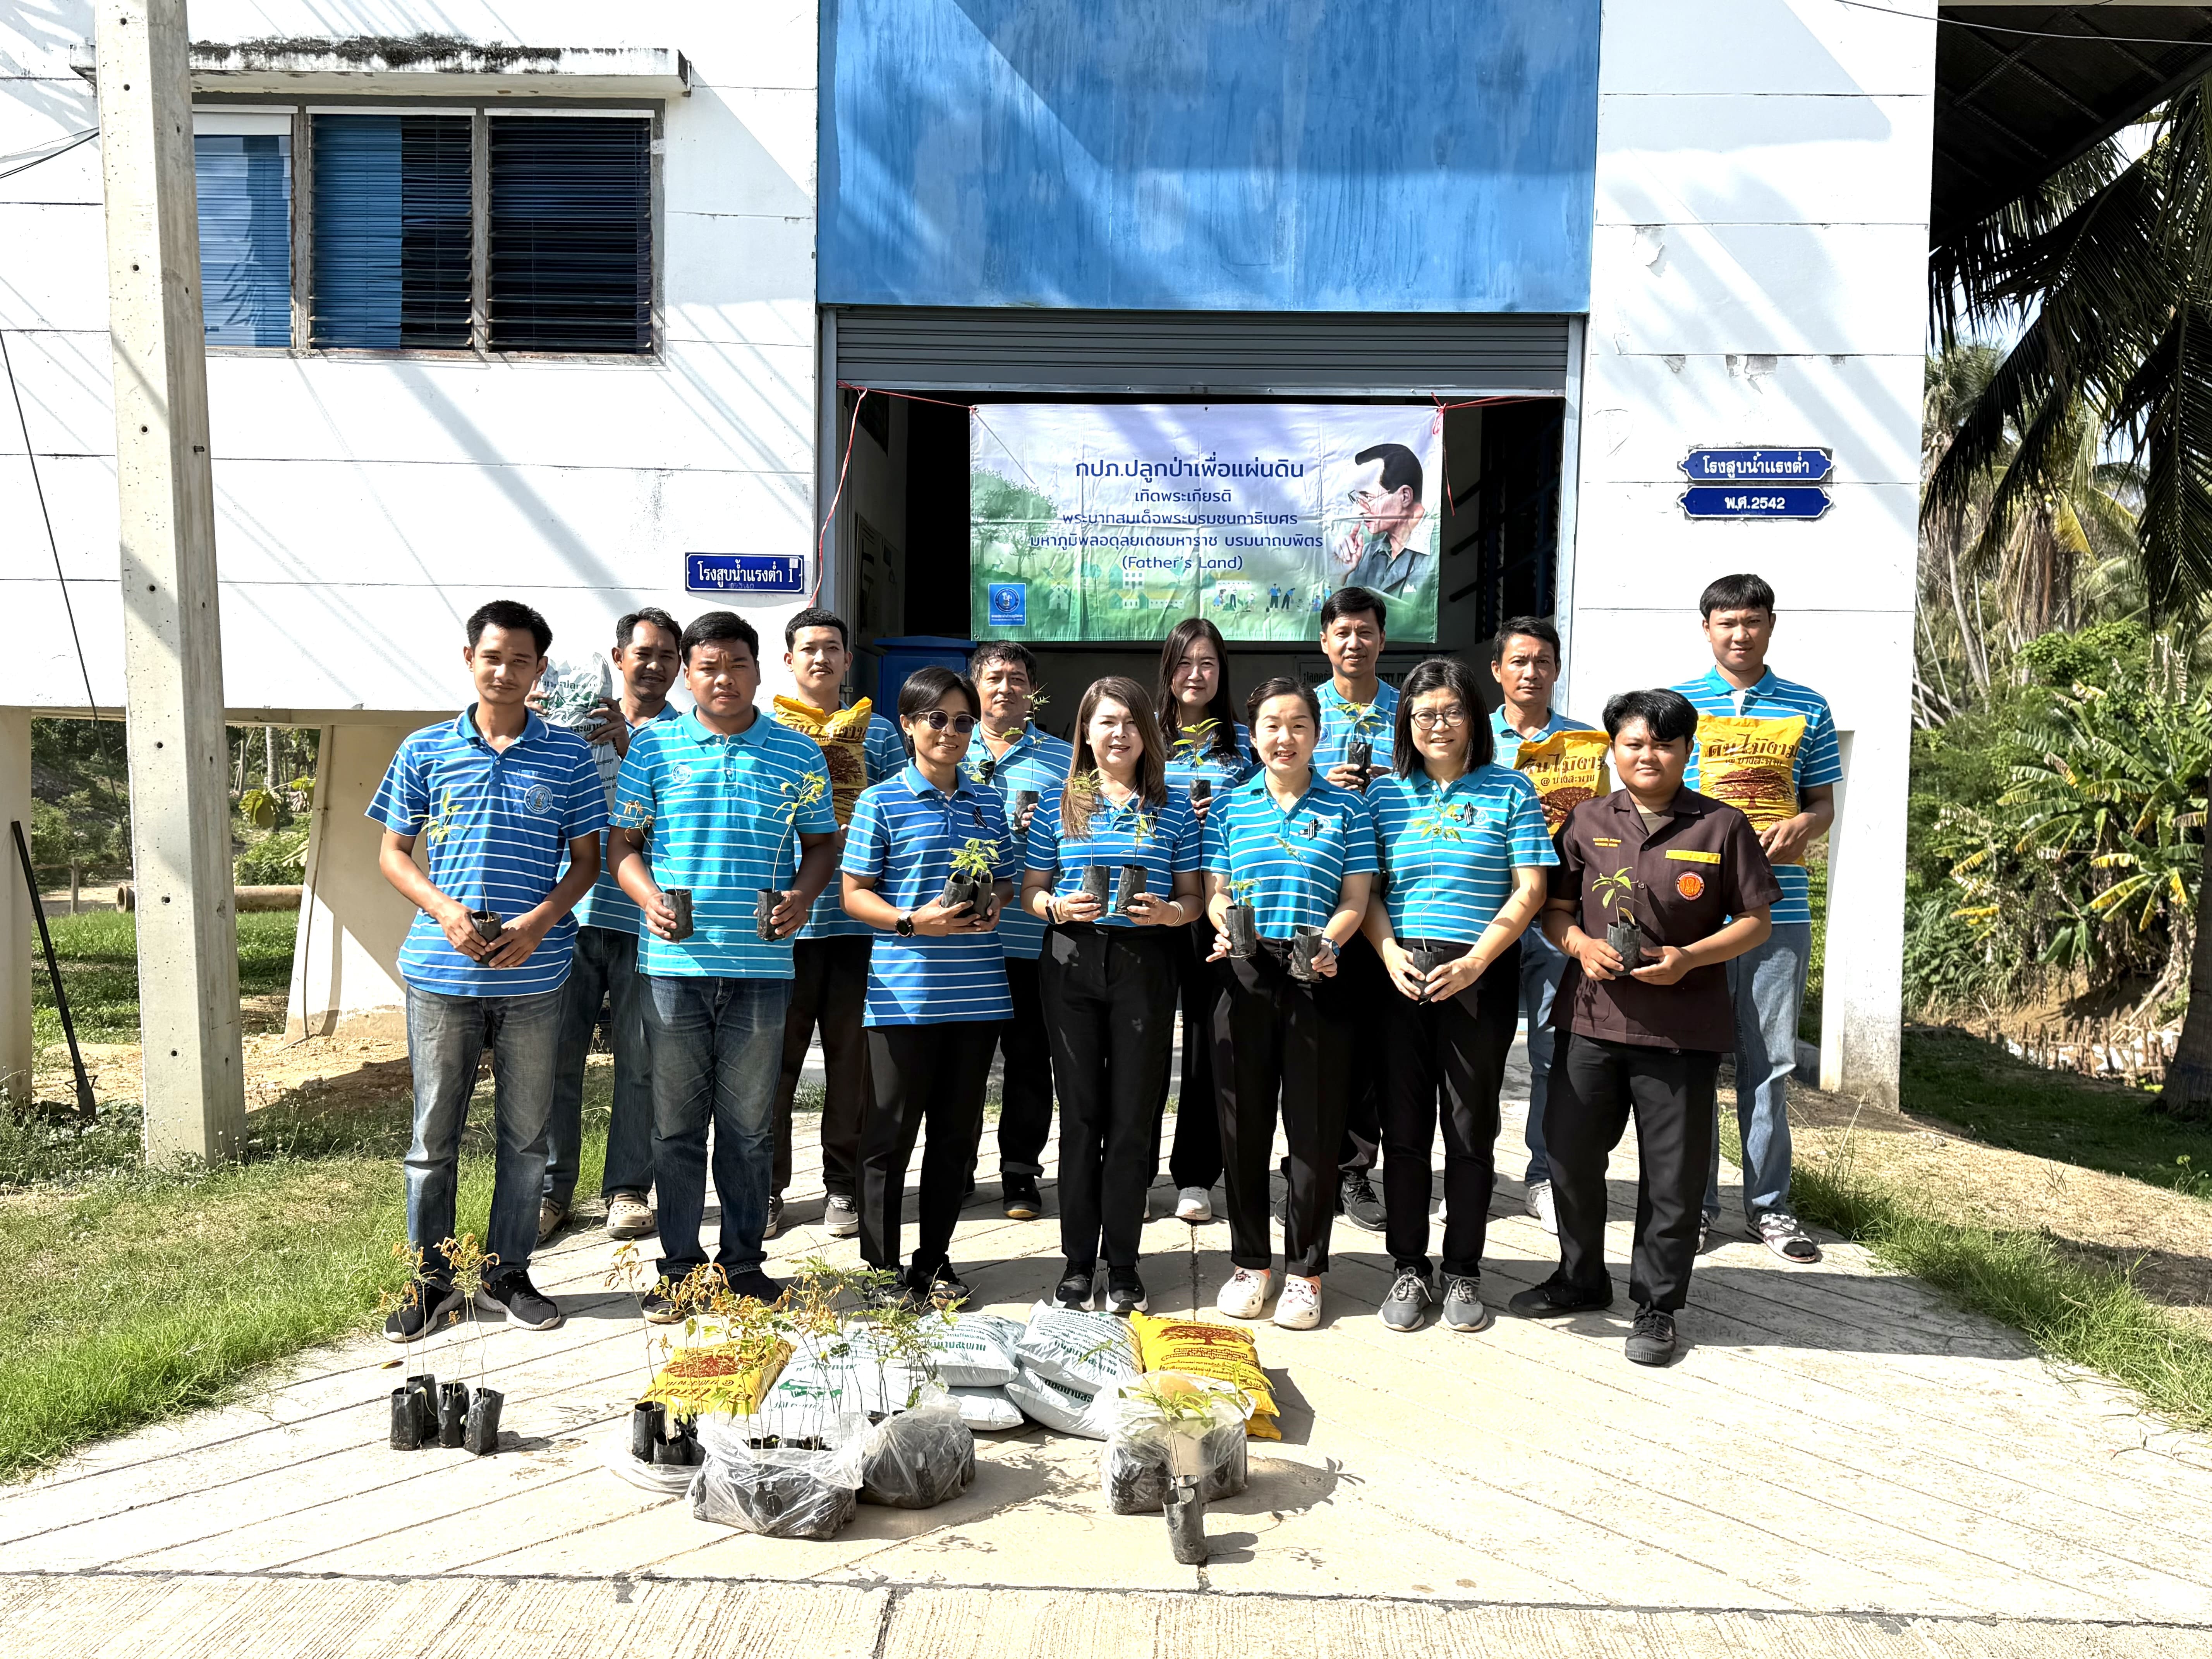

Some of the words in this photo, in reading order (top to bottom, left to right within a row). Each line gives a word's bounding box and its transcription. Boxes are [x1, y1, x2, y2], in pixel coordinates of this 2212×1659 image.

[1076, 452, 1304, 483] กปภ.ปลูกป่าเพื่อแผ่นดิน
[1703, 452, 1809, 478] โรงสูบน้ำแรงต่ำ
[1135, 489, 1231, 502] เทิดพระเกียรติ
[1724, 496, 1785, 511] พ.ศ.2542
[1063, 509, 1298, 524] พระบาทสมเด็จพระบรมชนกาธิเบศร
[1030, 533, 1218, 550] มหาภูมิพลอดุลยเดชมหาราช
[1225, 534, 1323, 547] บรมนาถบพิตร
[1200, 555, 1243, 570] Land)
[697, 559, 782, 588] โรงสูบน้ำแรงต่ำ
[1541, 777, 1550, 786] @
[1553, 775, 1595, 784] บางสะพาน
